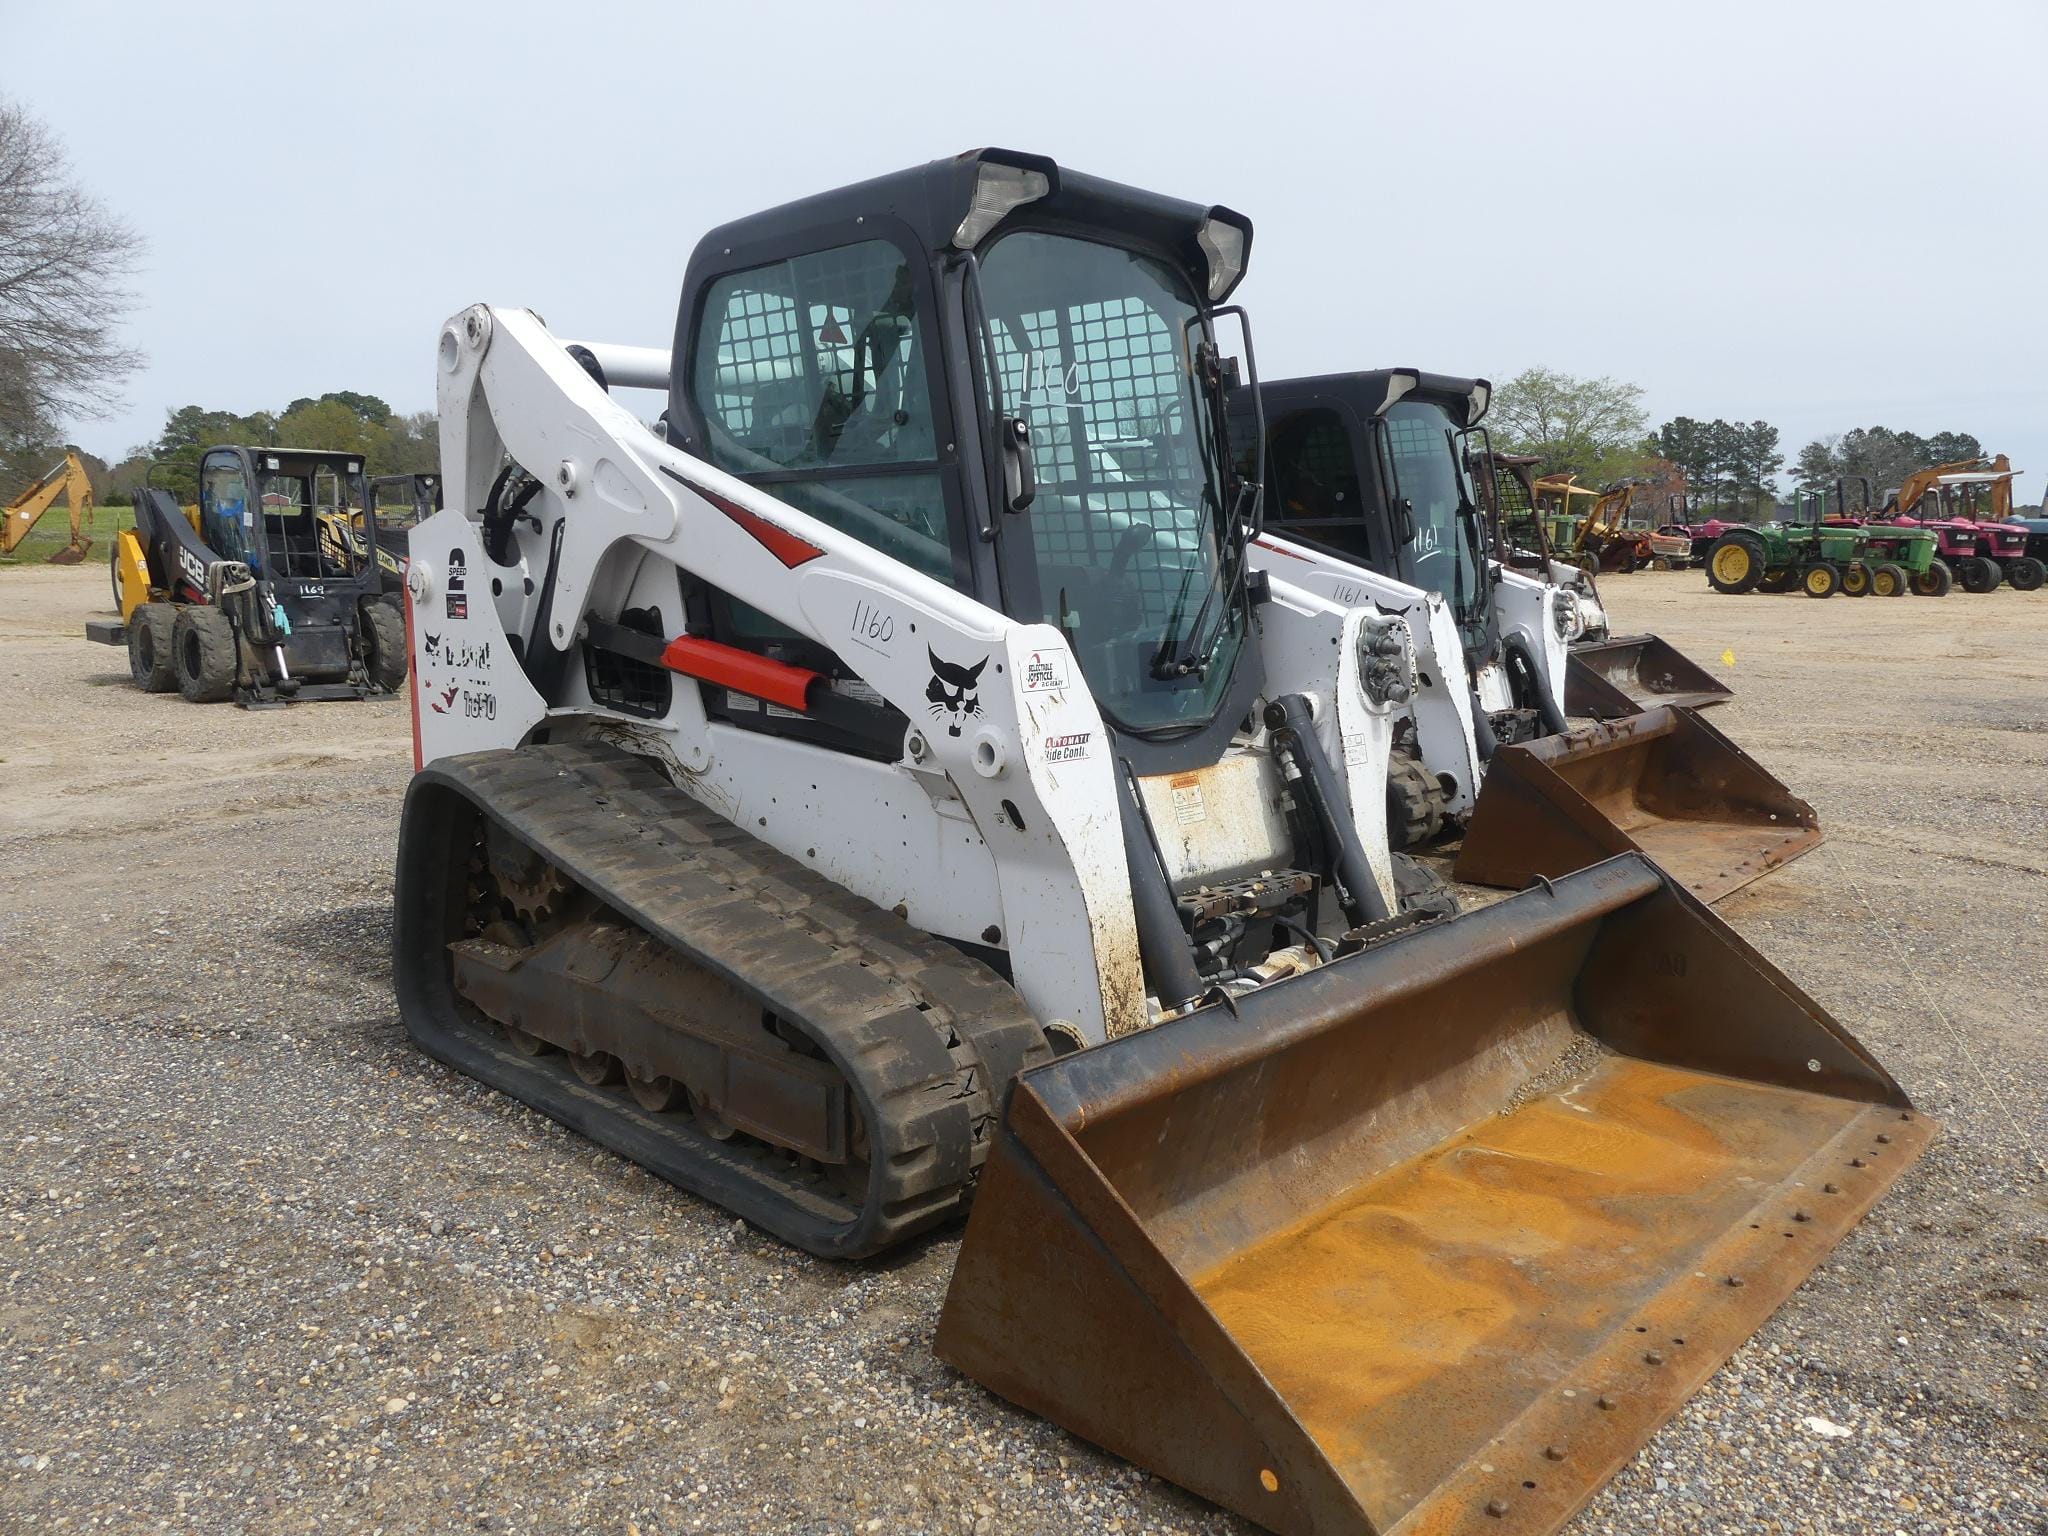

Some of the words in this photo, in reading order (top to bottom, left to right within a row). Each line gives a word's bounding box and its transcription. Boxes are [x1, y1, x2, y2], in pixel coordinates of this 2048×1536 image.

[1021, 350, 1080, 396] 1160
[1413, 524, 1438, 553] 1161
[179, 549, 205, 584] JCB
[448, 567, 467, 576] SPEED
[1333, 584, 1361, 605] 1161
[851, 600, 894, 642] 1160
[1028, 663, 1053, 672] SELECTABLE
[1046, 734, 1090, 748] AUTOMATI
